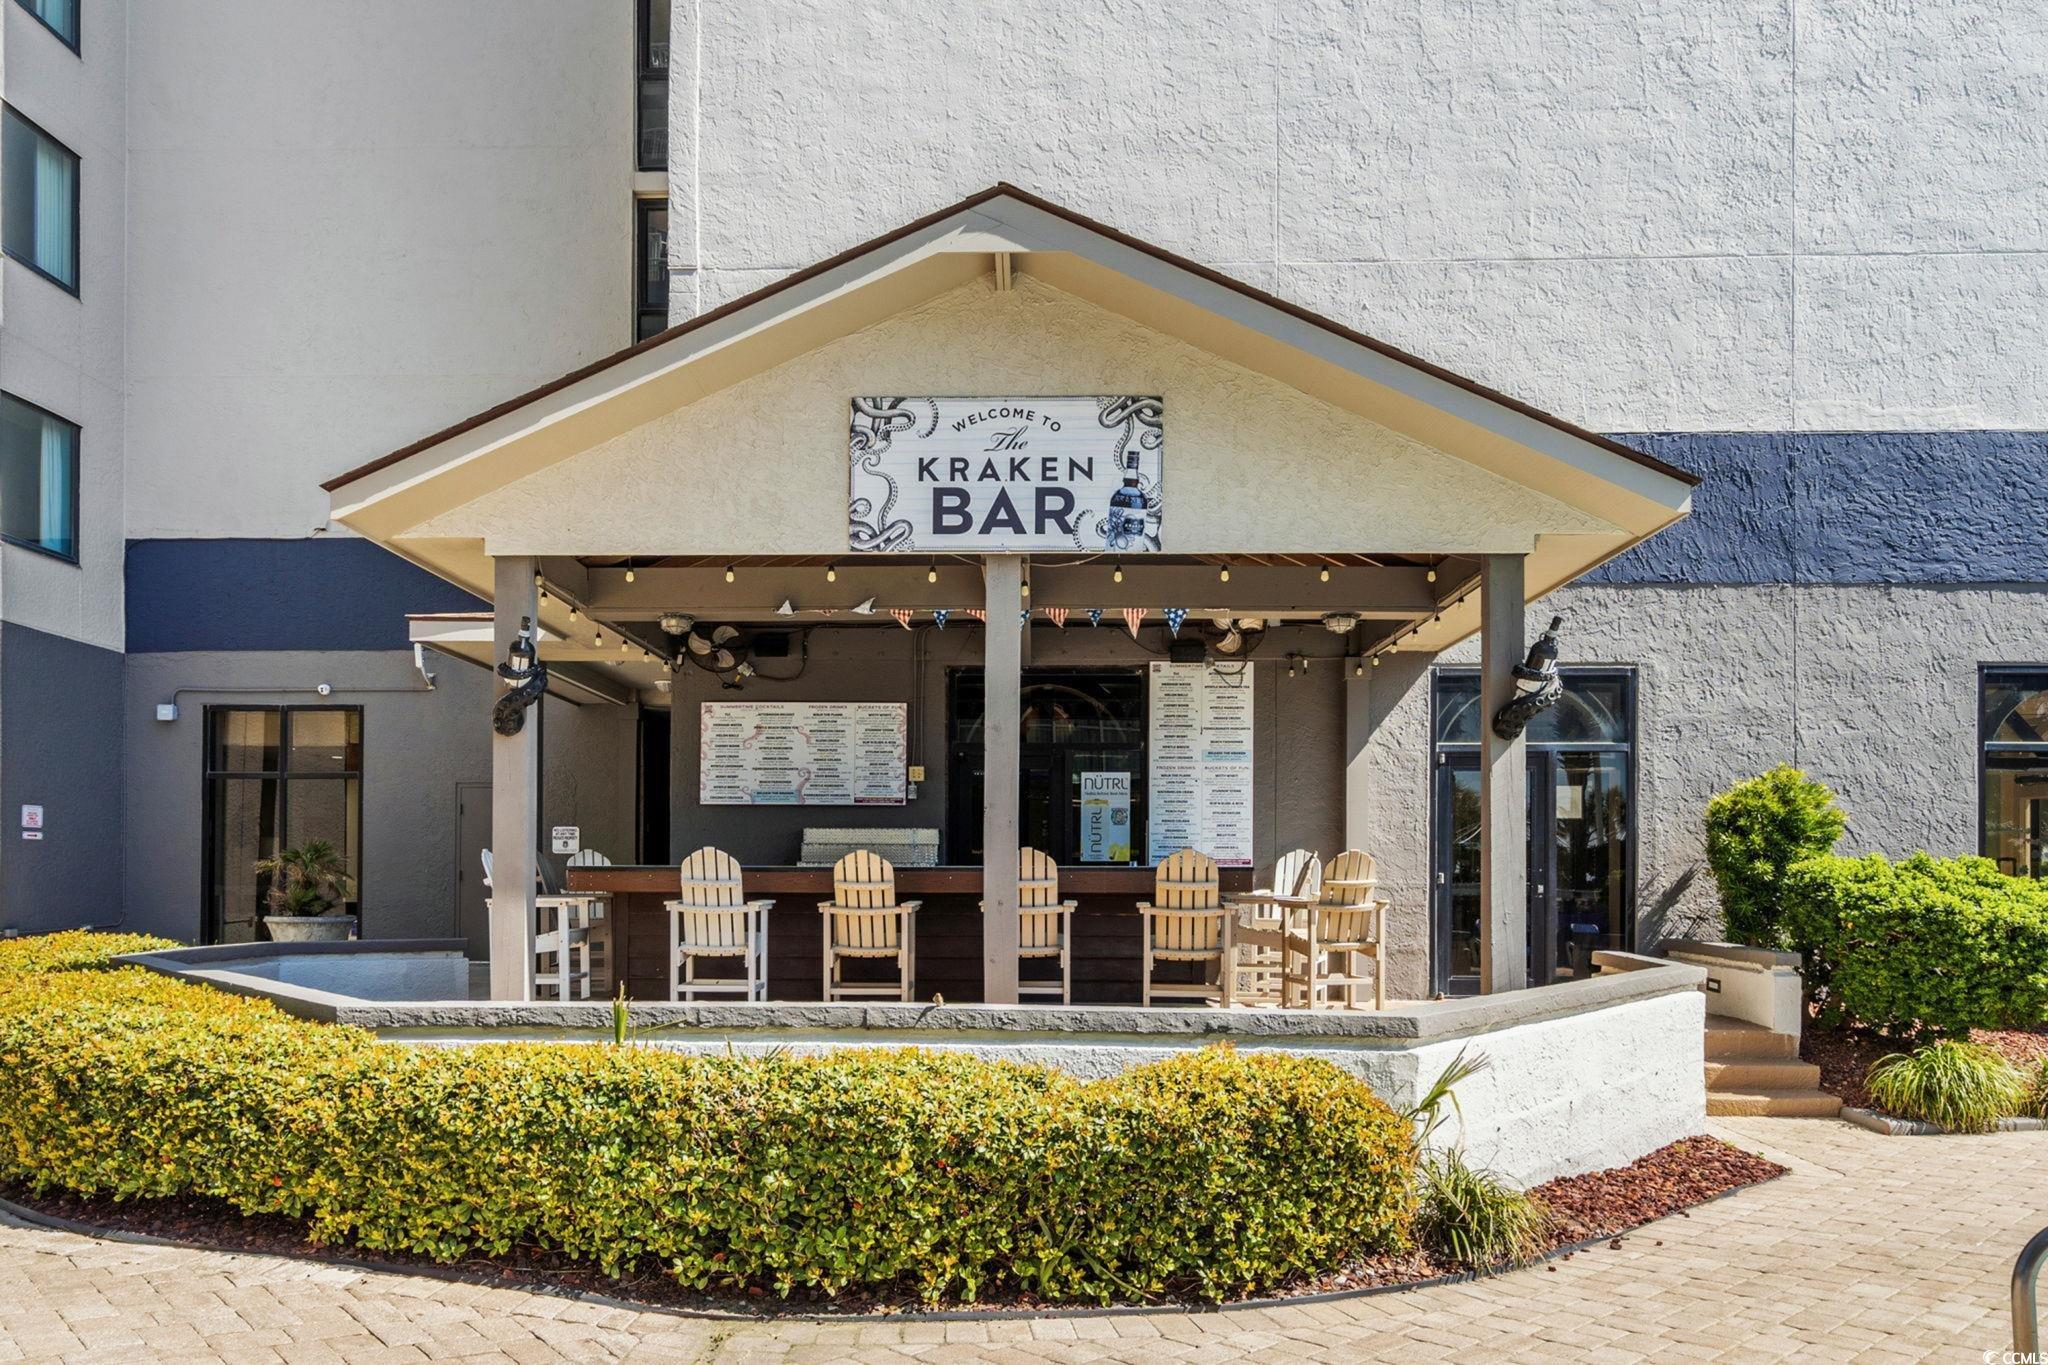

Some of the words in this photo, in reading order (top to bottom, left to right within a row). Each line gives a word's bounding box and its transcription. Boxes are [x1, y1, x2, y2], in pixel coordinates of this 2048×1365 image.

[952, 407, 1035, 432] WELCOME
[1042, 414, 1062, 432] TO
[984, 426, 1030, 452] The
[918, 457, 1093, 481] KRAKEN
[932, 487, 1075, 534] BAR
